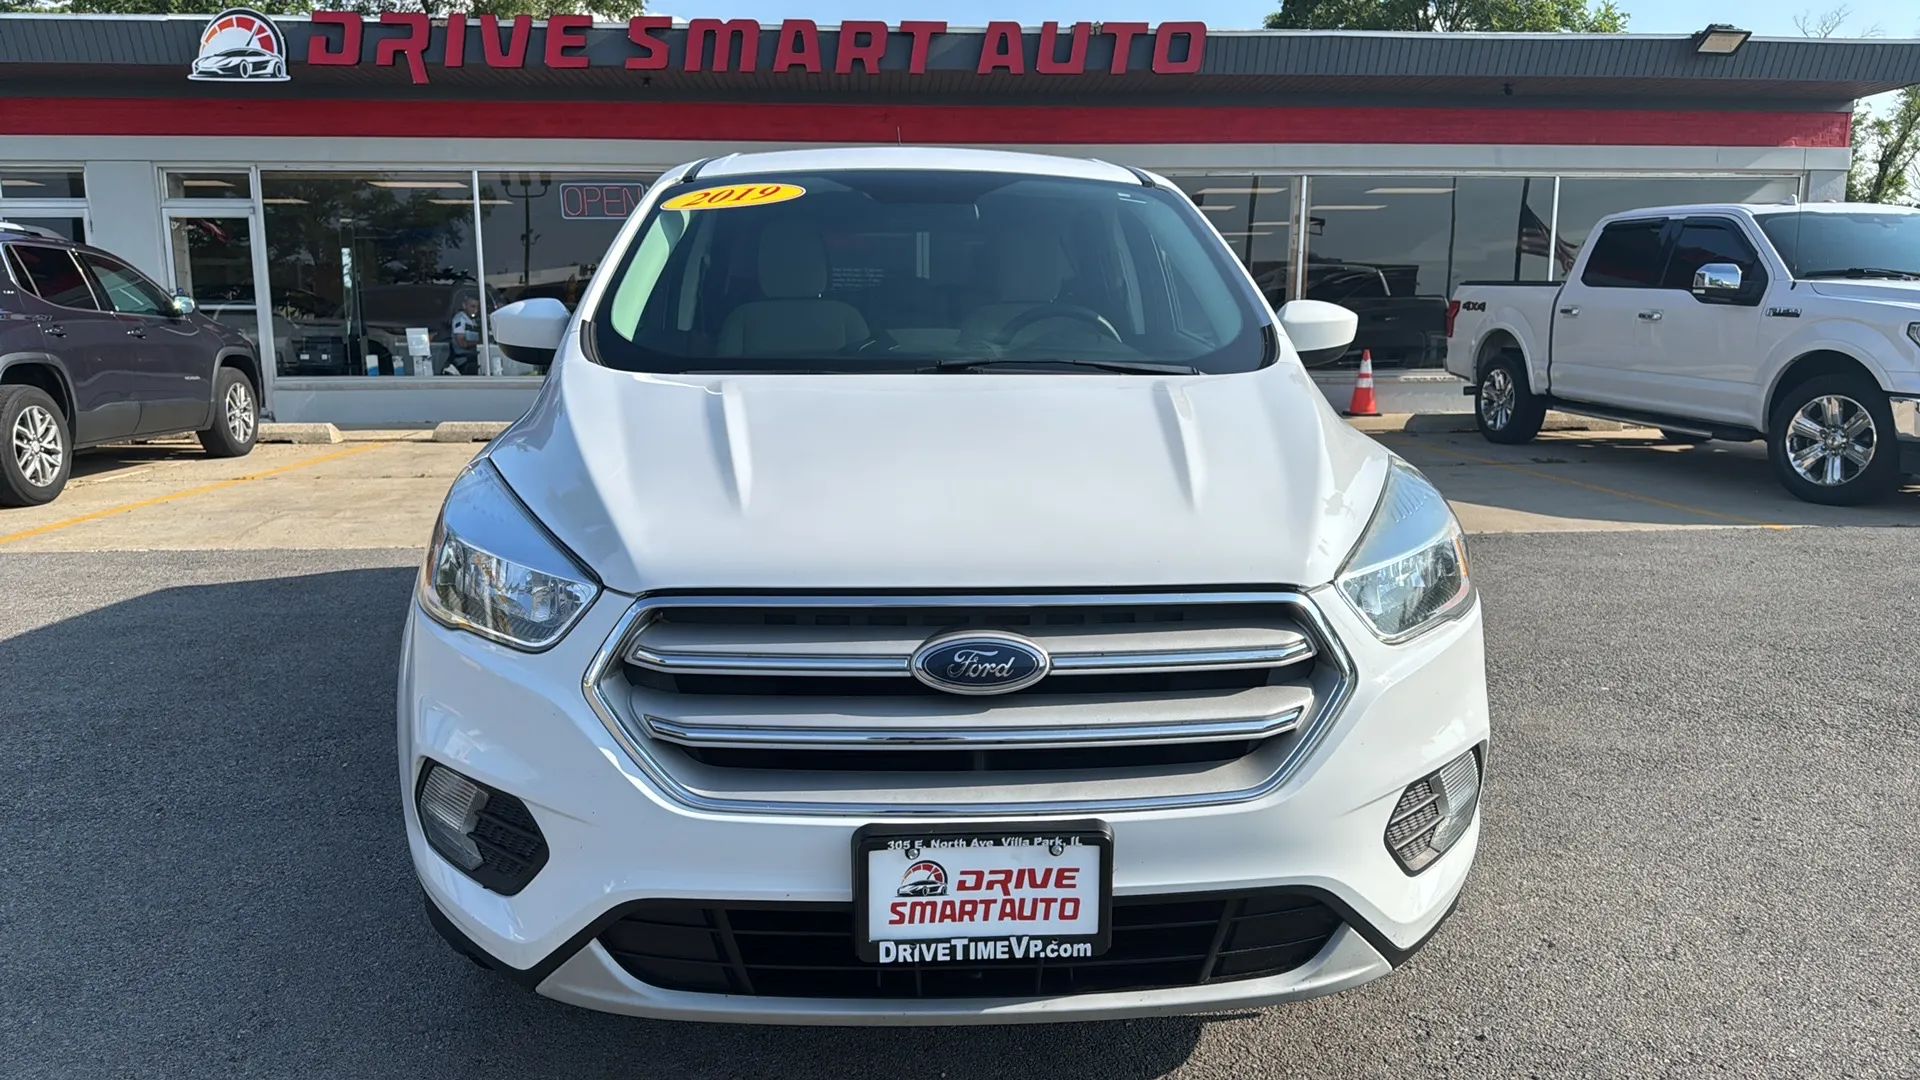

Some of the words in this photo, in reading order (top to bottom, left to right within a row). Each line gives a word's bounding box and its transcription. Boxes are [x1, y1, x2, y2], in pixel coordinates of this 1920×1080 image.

[308, 12, 594, 85] DRIVE
[625, 16, 948, 75] SMART
[977, 20, 1208, 75] AUTO
[564, 187, 641, 216] OPEN
[682, 185, 781, 208] 2019
[946, 648, 1016, 678] Ford
[887, 839, 911, 850] 305
[914, 839, 927, 849] E.
[930, 838, 967, 849] North
[1001, 836, 1030, 847] Villa
[956, 867, 1081, 897] DRIVE
